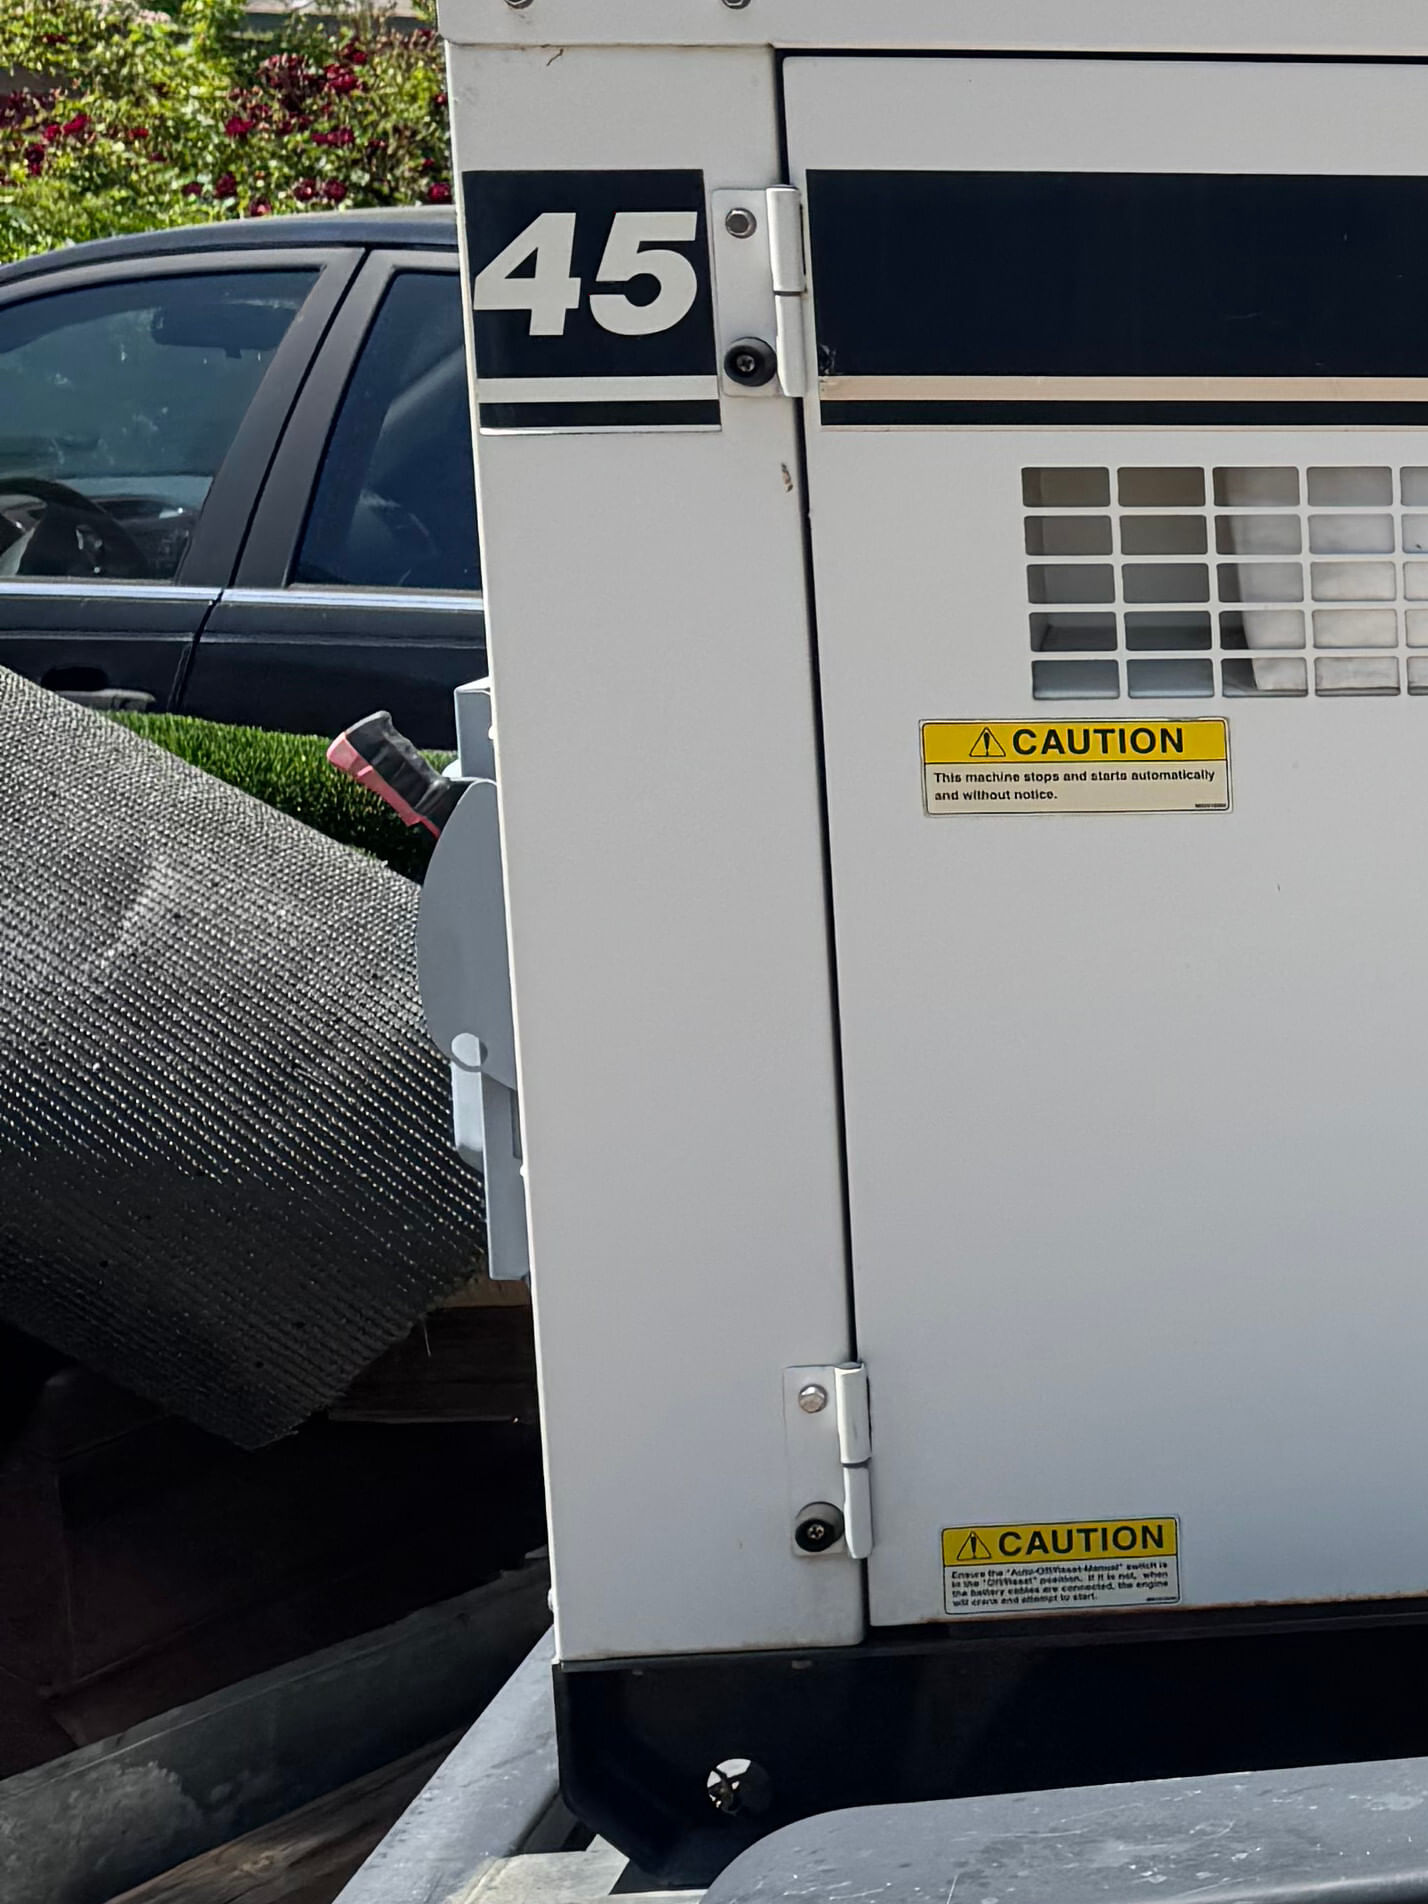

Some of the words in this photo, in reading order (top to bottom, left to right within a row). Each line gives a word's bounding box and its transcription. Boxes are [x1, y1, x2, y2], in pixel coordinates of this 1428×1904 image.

[473, 211, 698, 336] 45
[1012, 727, 1184, 755] CAUTION
[934, 772, 962, 783] This
[965, 771, 1020, 783] machine
[1024, 771, 1060, 784] stops
[1063, 770, 1087, 781] and
[1091, 770, 1127, 781] starts
[1131, 768, 1215, 783] automatically
[934, 789, 959, 801] and
[963, 788, 1011, 801] without
[1014, 788, 1057, 800] notice.
[998, 1524, 1163, 1556] CAUTION
